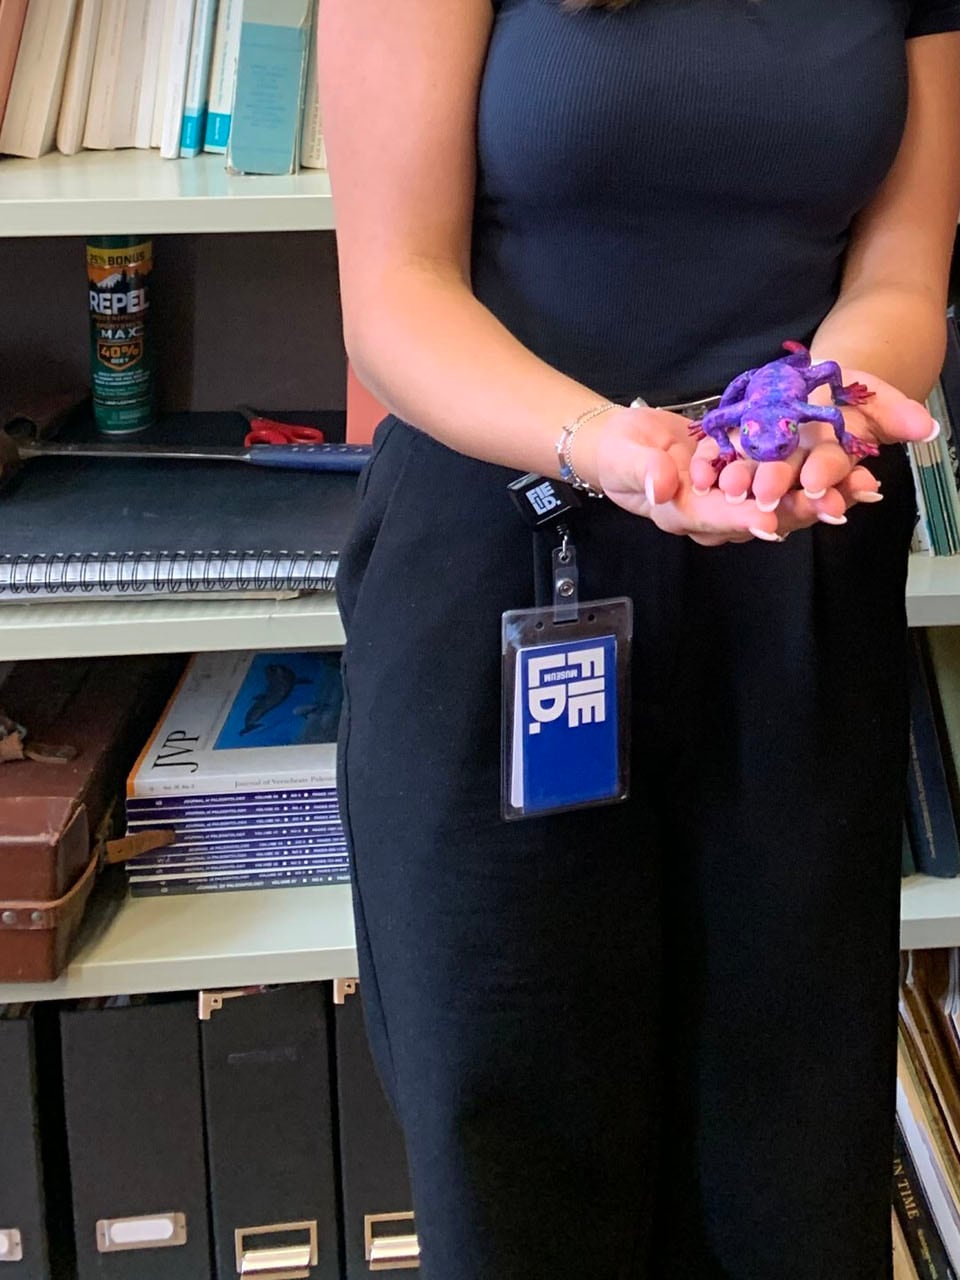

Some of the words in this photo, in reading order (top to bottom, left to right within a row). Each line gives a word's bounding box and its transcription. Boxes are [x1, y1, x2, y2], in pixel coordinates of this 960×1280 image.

[108, 252, 145, 266] BONUS
[101, 329, 138, 340] MAX
[101, 345, 139, 359] 40%
[543, 669, 578, 682] MUSEUM
[152, 729, 200, 773] JVP
[898, 1176, 919, 1220] TIME
